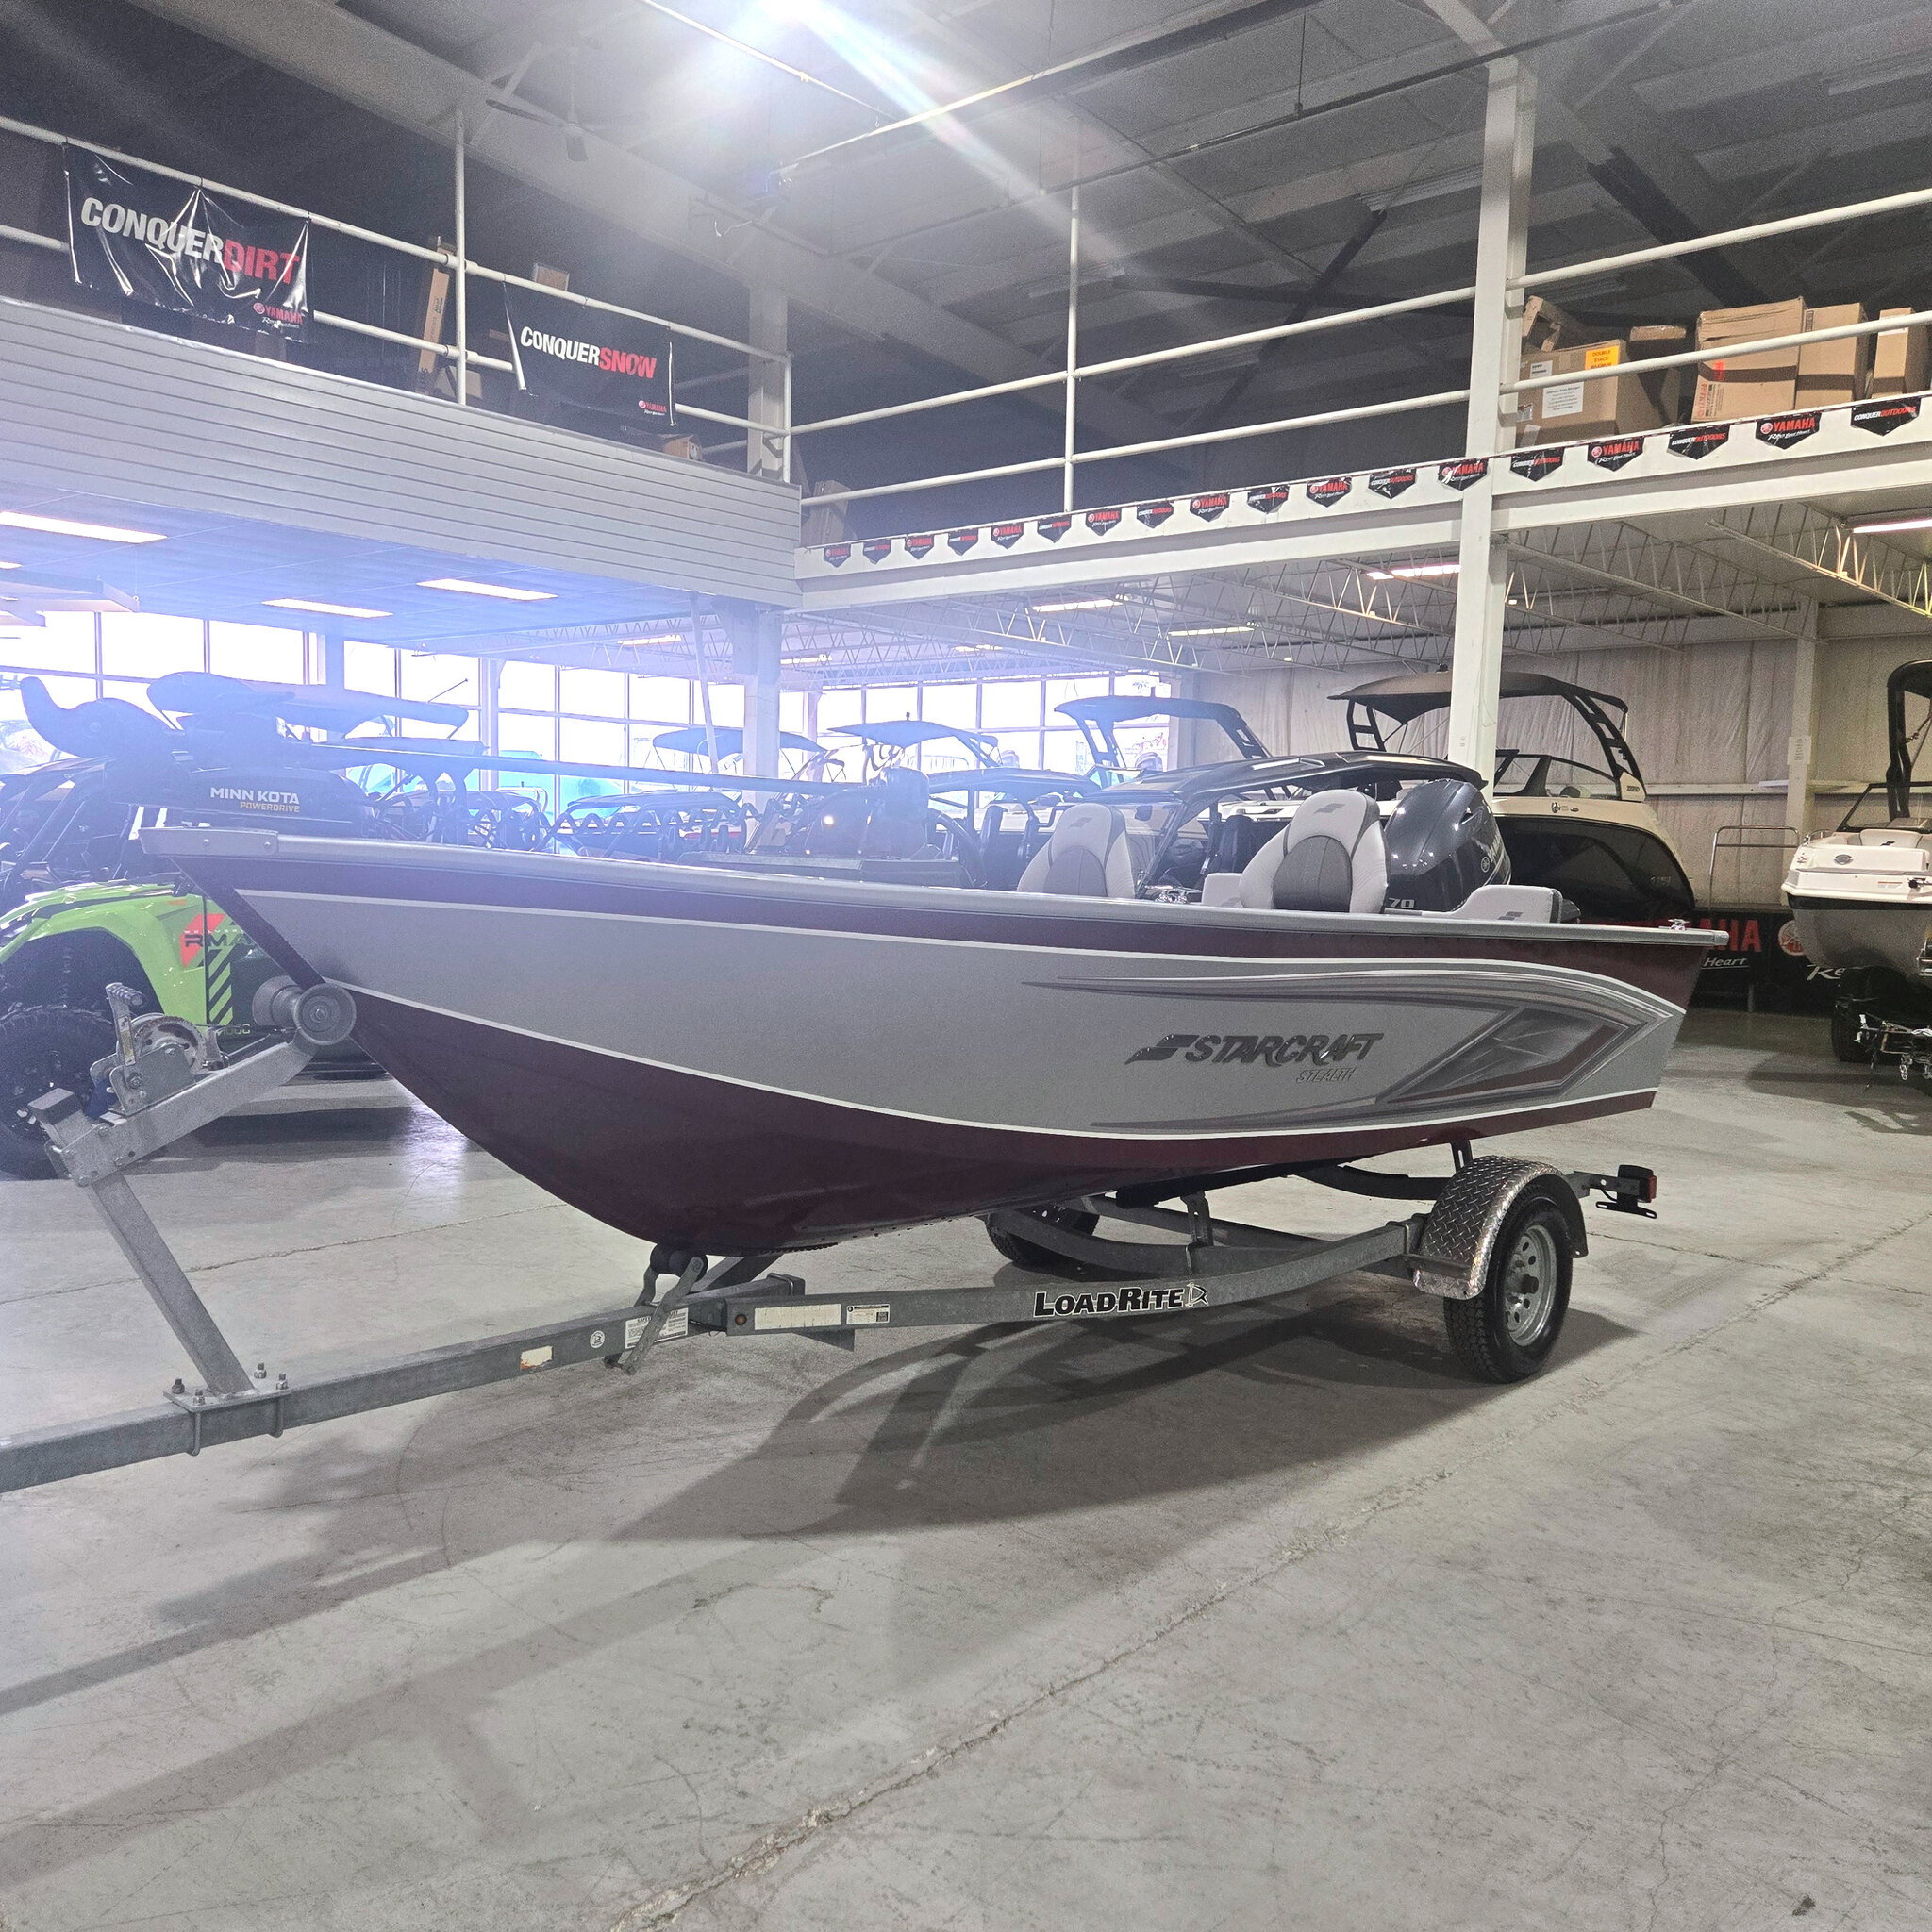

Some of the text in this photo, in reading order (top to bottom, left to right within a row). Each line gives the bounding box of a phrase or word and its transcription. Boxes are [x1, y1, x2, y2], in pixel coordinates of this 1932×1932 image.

[81, 197, 301, 284] CONQUERDIRT
[265, 305, 303, 325] YAMAHA
[520, 326, 657, 378] CONQUERSNOW
[1773, 417, 1815, 432] YAMAHA
[1602, 440, 1639, 456] YAMAHA
[1318, 480, 1347, 492] YAMAHA
[1201, 496, 1226, 508] YAMAHA
[210, 787, 300, 804] MINN KOTA
[240, 802, 300, 812] POWERDRIVE
[1388, 898, 1415, 909] 70
[184, 933, 253, 948] RMA
[1704, 957, 1747, 967] Heart
[1186, 1033, 1384, 1067] STARCRAFT
[1296, 1067, 1357, 1083] STEALTH
